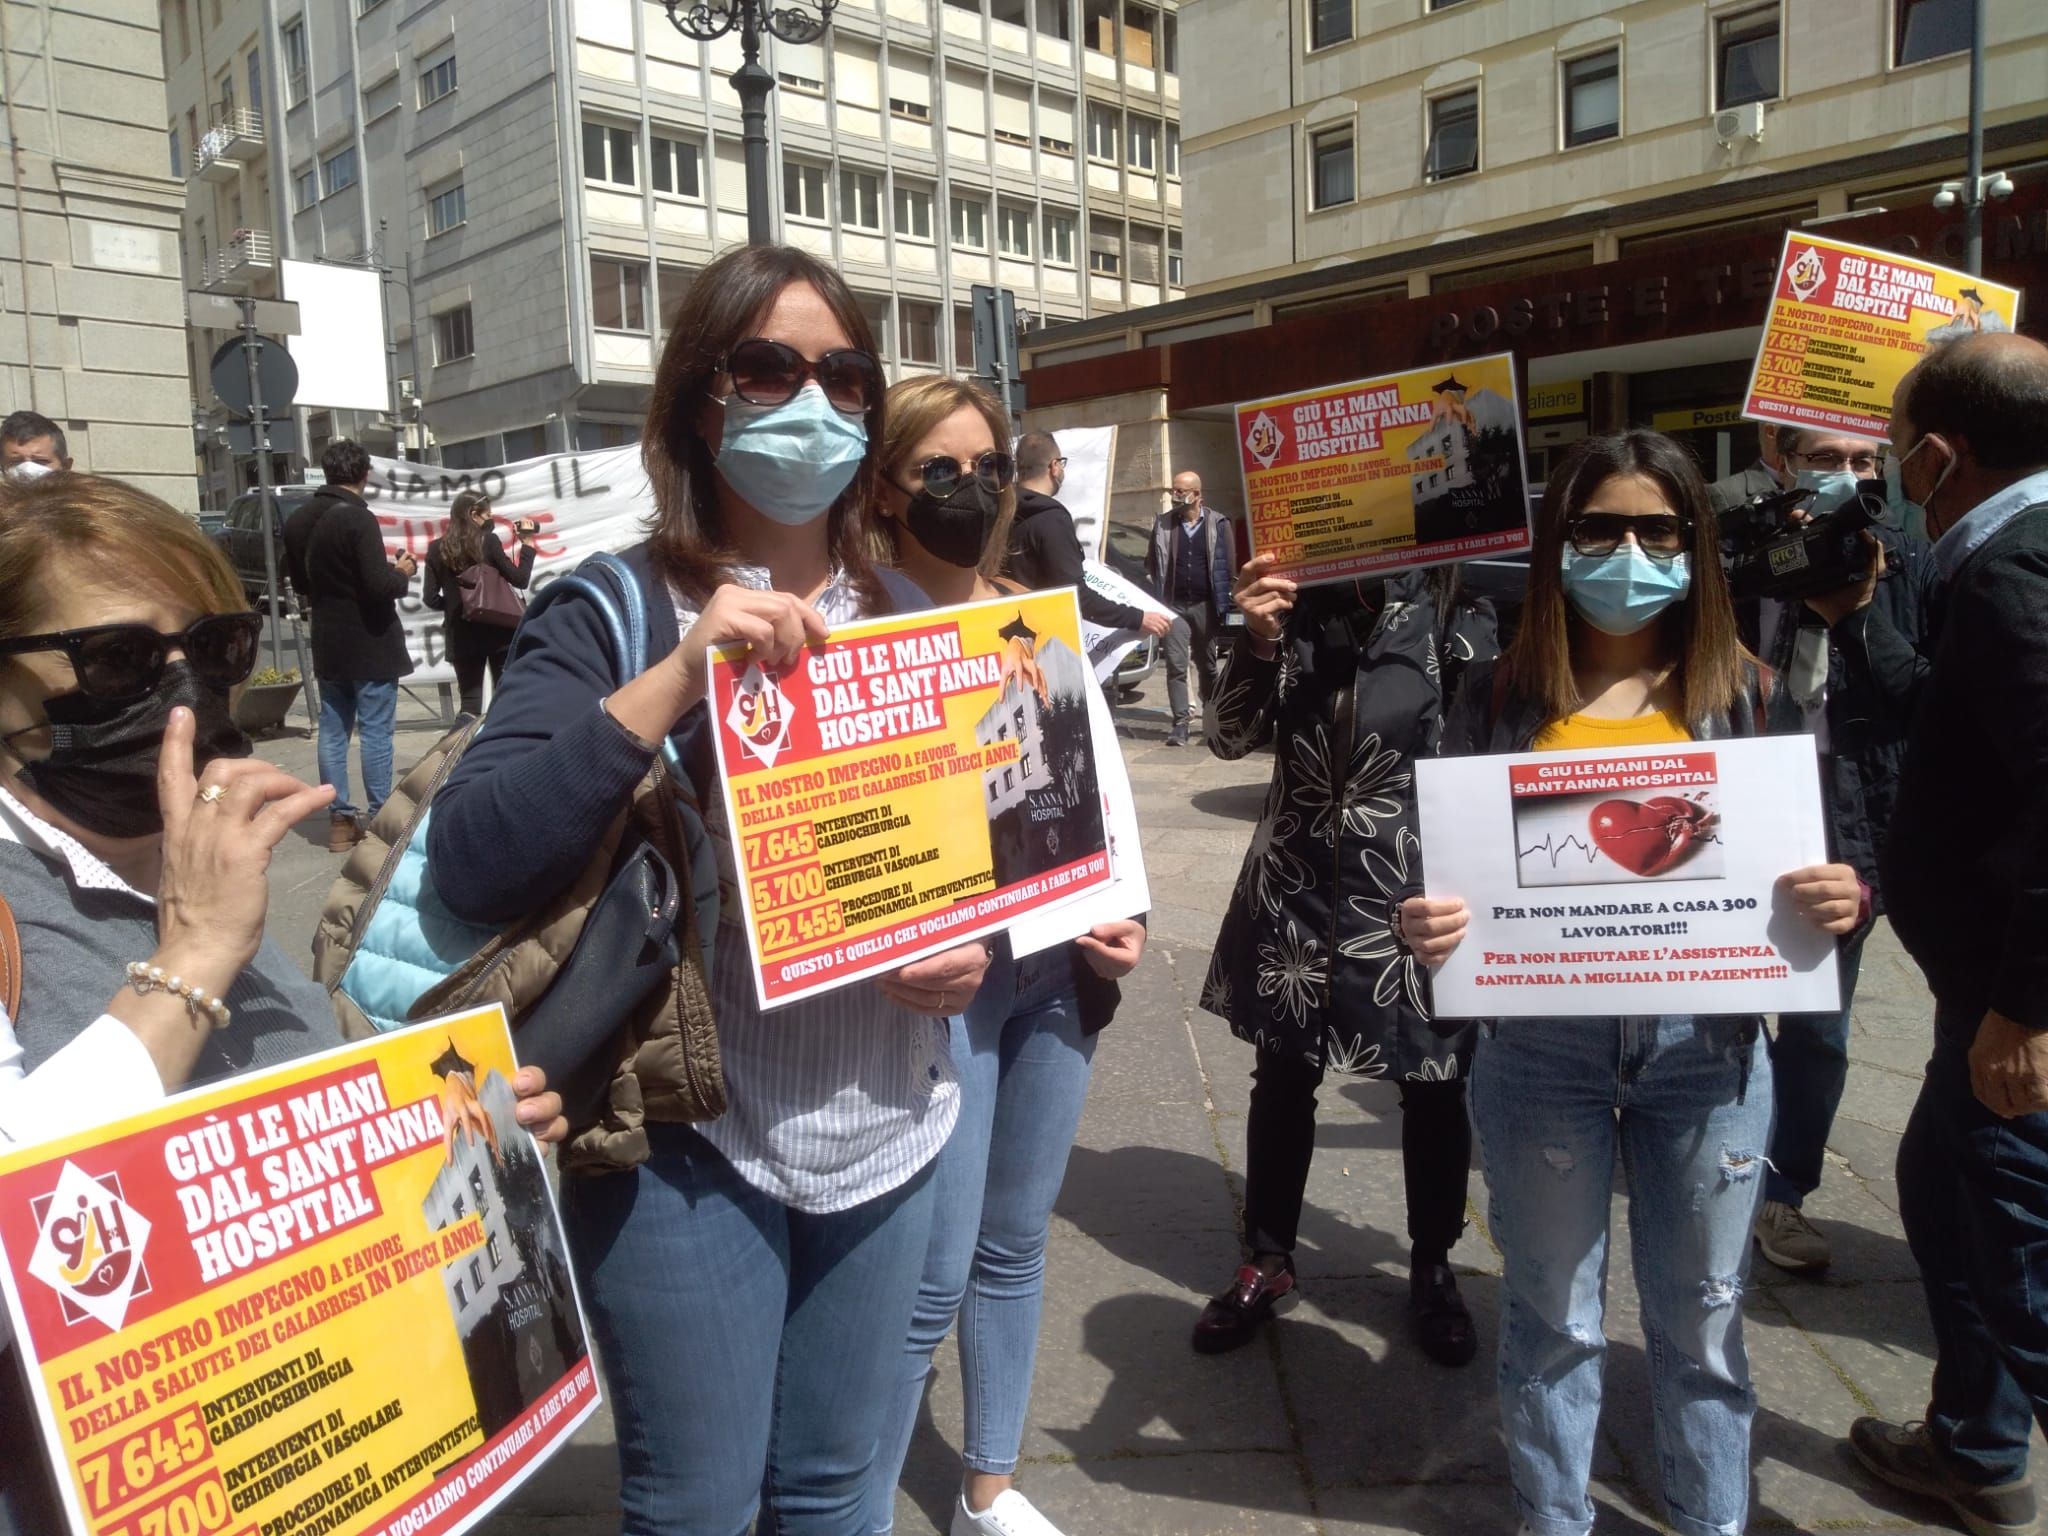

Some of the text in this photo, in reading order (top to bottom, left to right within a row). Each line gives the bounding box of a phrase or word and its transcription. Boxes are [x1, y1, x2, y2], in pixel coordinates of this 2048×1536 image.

[1834, 273, 1958, 314] DAL SANT'ANNA
[1838, 256, 1935, 292] GIÙ LE MANI
[1431, 284, 1610, 349] POSTE
[1633, 275, 1668, 318] E
[1775, 305, 1880, 334] IL NOSTRO IMPEGNO A
[1830, 290, 1910, 320] HOSPITAL
[1765, 330, 1809, 352] 7.645
[1759, 353, 1804, 375] 5.700
[1292, 387, 1399, 426] GIÙ LE MANI
[1753, 374, 1806, 398] 22.455
[1295, 420, 1327, 443] DAL
[1297, 428, 1380, 461] HOSPITAL
[551, 457, 611, 499] IL
[1248, 479, 1257, 489] IL
[1260, 471, 1298, 487] NOSTRO
[1301, 462, 1349, 481] IMPEGNO
[1351, 463, 1357, 472] A
[1369, 463, 1411, 480] IN DIECI
[1251, 500, 1288, 521] 7.645
[1254, 522, 1293, 544] 5.700
[806, 630, 961, 686] GIÙ LE MANI
[812, 653, 1001, 719] DAL SANT'ANNA
[817, 696, 940, 752] HOSPITAL
[736, 742, 957, 808] IL NOSTRO IMPEGNO A FAVORE
[1538, 758, 1687, 778] GIU LE MANI DAL
[1622, 771, 1716, 786] HOSPITAL
[741, 803, 784, 828] DELLA
[786, 790, 836, 817] SALUTE
[838, 785, 860, 803] DEI
[863, 767, 927, 798] CALABRESI
[928, 761, 945, 780] IN
[947, 752, 981, 776] DIECI
[814, 803, 892, 836] INTERVENTI DI
[816, 812, 910, 851] CARDIOCHIRURGIA
[1030, 802, 1064, 826] HOSPITAL
[744, 822, 815, 870] 7.645
[823, 844, 900, 878] INTERVENTI DI
[752, 864, 823, 914] 5.700
[825, 846, 939, 893] CHIRURGIA VASCOLARE
[841, 880, 912, 914] PROCEDURE DI
[844, 892, 917, 929] EMODINAMICA
[1657, 901, 1669, 914] A
[1722, 897, 1758, 912] 300
[759, 899, 843, 956] 22.455
[780, 950, 833, 985] QUESTO
[834, 945, 843, 964] È
[845, 931, 892, 962] QUELLO
[894, 923, 918, 945] CHE
[919, 903, 976, 937] VOGLIAMO
[977, 881, 1039, 916] CONTINUARE
[1040, 878, 1048, 893] A
[1048, 870, 1070, 889] FARE
[1071, 863, 1087, 881] PER
[1570, 972, 1583, 984] A
[159, 1073, 387, 1185] GIÙ LE MANI
[174, 1098, 444, 1236] DAL SANT'ANNA
[190, 1171, 373, 1287] HOSPITAL
[58, 1232, 403, 1414] IL NOSTRO IMPEGNO A FAVORE
[507, 1295, 543, 1335] HOSPITAL
[70, 1386, 152, 1448] DELLA
[153, 1344, 234, 1406] SALUTE
[236, 1327, 271, 1363] DEI
[273, 1279, 367, 1346] CALABRESI
[366, 1264, 391, 1297] IN
[390, 1241, 439, 1284] DIECI
[202, 1344, 325, 1428] INTERVENTI DI
[208, 1351, 354, 1454] CARDIOCHIRURGIA
[79, 1404, 208, 1519] 7.645
[223, 1407, 345, 1497] INTERVENTI DI
[230, 1394, 403, 1522] CHIRURGIA VASCOLARE
[390, 1468, 467, 1536] VOGLIAMO
[464, 1419, 535, 1489] CONTINUARE
[531, 1411, 544, 1433] A
[538, 1394, 561, 1426] FARE
[558, 1380, 578, 1407] PER
[261, 1461, 371, 1536] PROCEDURE DI
